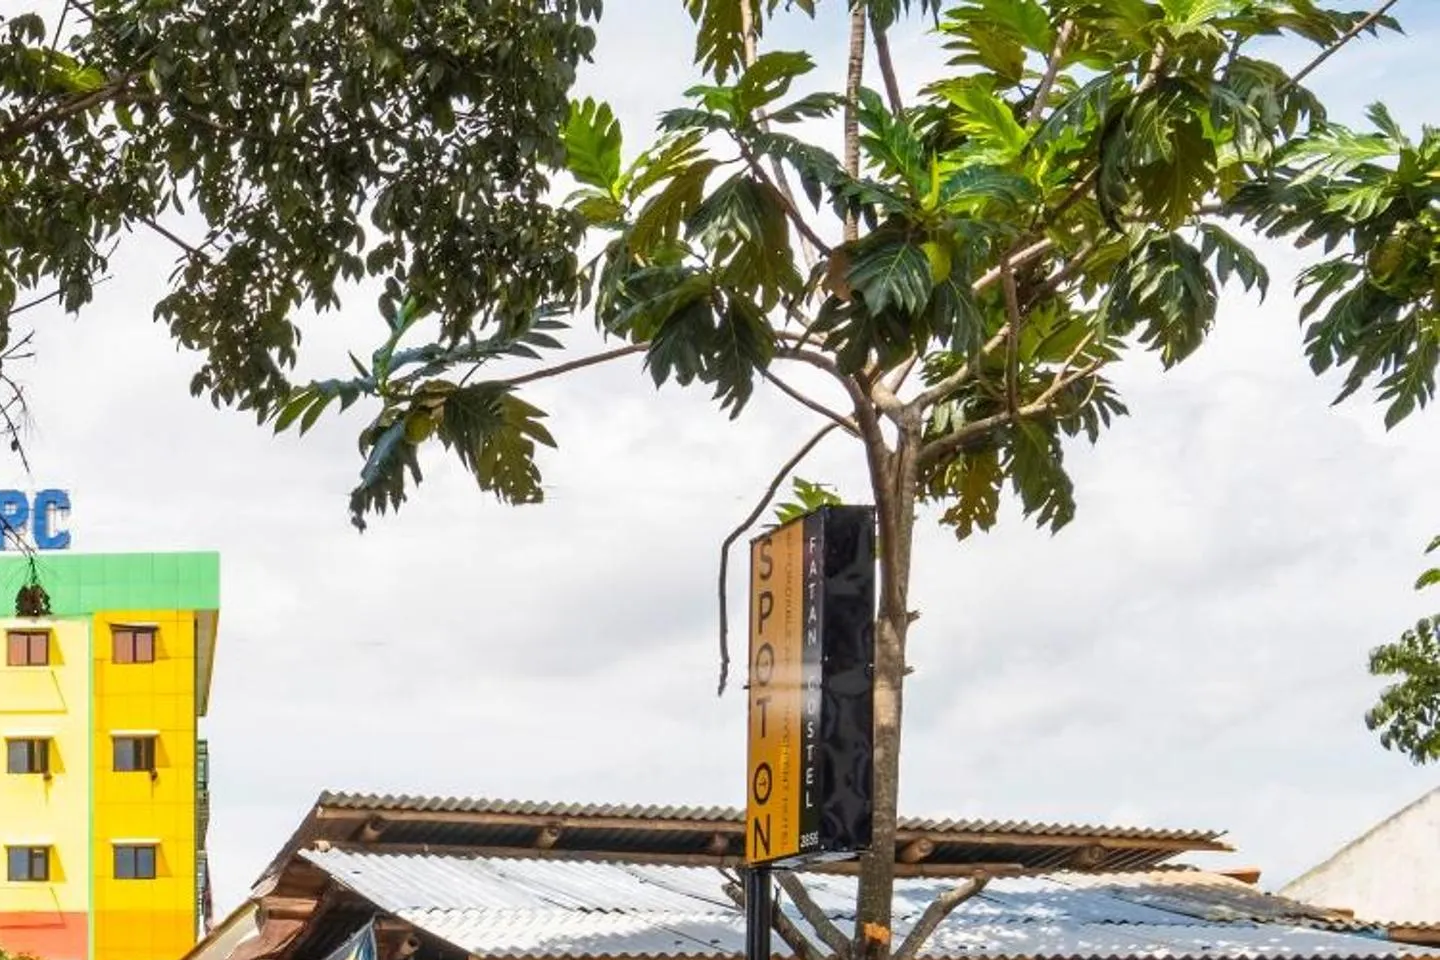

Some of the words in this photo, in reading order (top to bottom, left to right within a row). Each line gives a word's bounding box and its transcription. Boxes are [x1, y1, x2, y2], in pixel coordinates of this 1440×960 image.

[756, 538, 775, 738] SPOT
[807, 536, 818, 645] FATAN
[753, 762, 773, 858] ON
